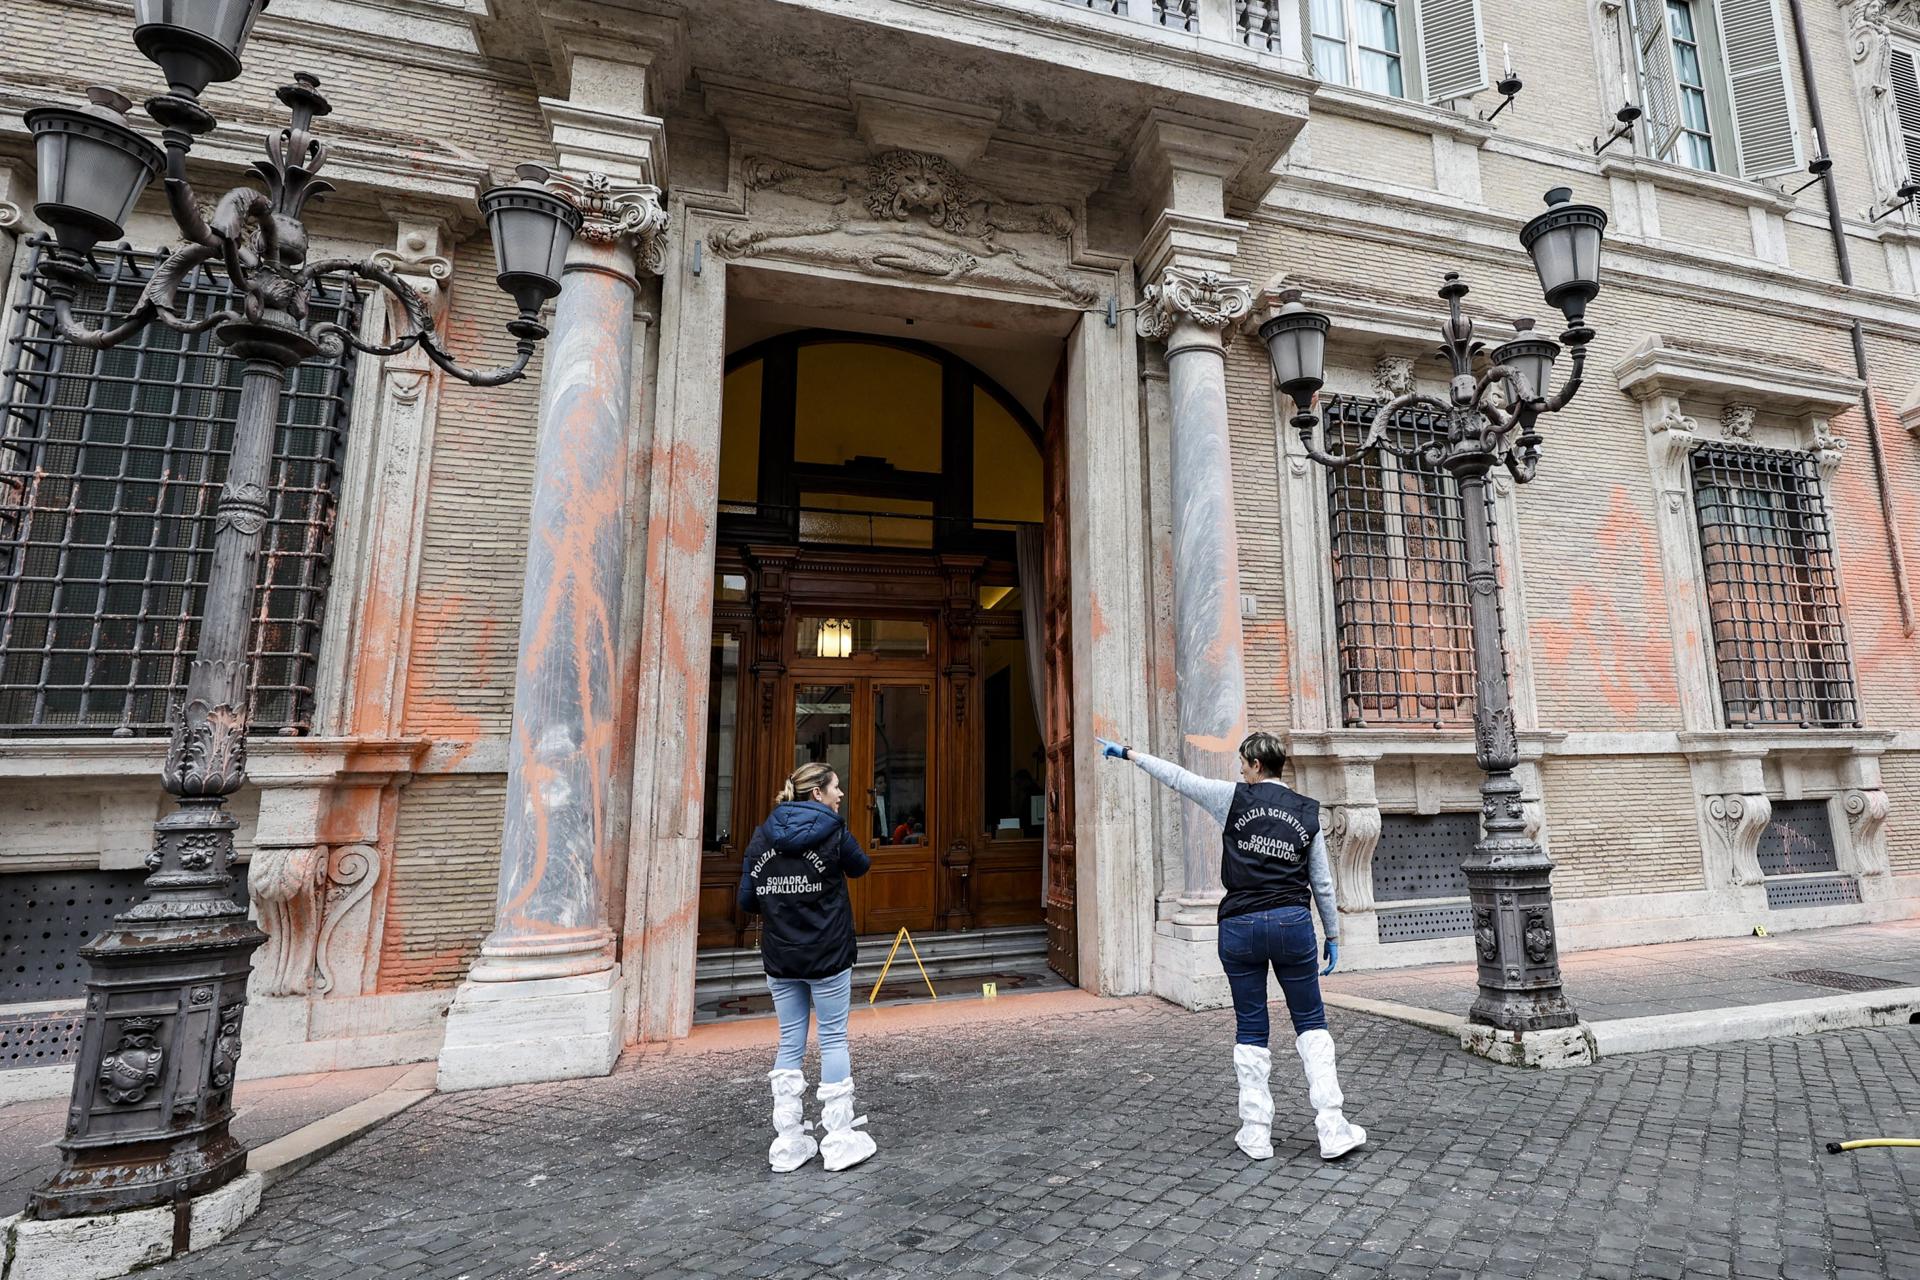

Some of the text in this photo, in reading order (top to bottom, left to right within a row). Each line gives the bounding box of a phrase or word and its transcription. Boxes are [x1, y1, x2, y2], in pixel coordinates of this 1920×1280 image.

[1234, 807, 1310, 847] POLIZIA SCIENTIFICA
[1250, 834, 1295, 853] SQUADRA
[750, 848, 776, 878] POLIZIA
[756, 882, 822, 896] SOPRALLUOGHI
[766, 875, 809, 886] SQUADRA
